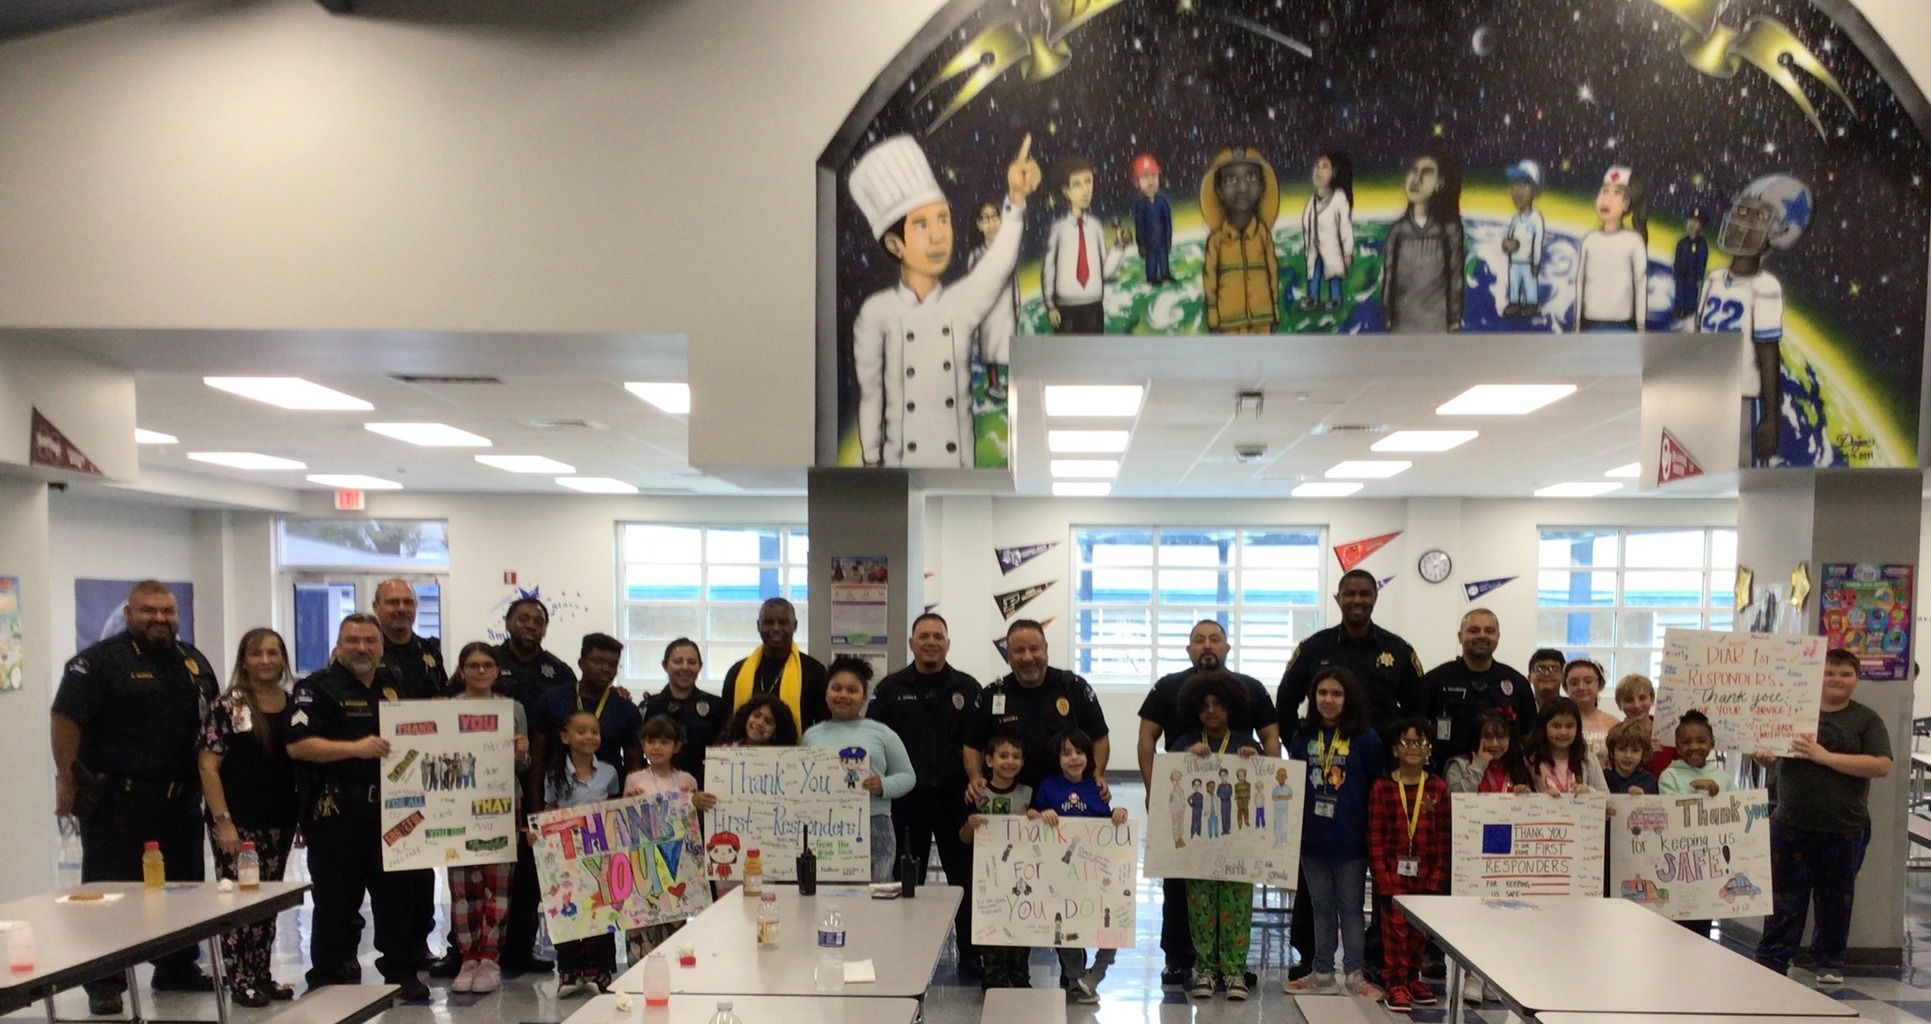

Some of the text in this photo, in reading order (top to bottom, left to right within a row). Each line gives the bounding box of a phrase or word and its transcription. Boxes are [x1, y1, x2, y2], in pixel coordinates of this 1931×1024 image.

[1703, 297, 1744, 332] 22
[1706, 647, 1744, 665] DEAR
[1692, 685, 1747, 704] Thank
[397, 714, 497, 735] THANK YOU
[720, 761, 831, 796] Thank You
[473, 797, 511, 815] THAT
[1676, 796, 1741, 828] Thank
[541, 800, 675, 860] THANK
[713, 806, 753, 836] First
[1002, 819, 1068, 844] Thank
[1514, 827, 1567, 840] THANK YOU
[1631, 832, 1735, 854] for keeping us
[1535, 843, 1567, 856] FIRST
[1014, 861, 1045, 880] For
[1485, 859, 1569, 873] RESPONDERS
[1656, 845, 1731, 883] SAFE!
[1505, 880, 1530, 889] KEEPING
